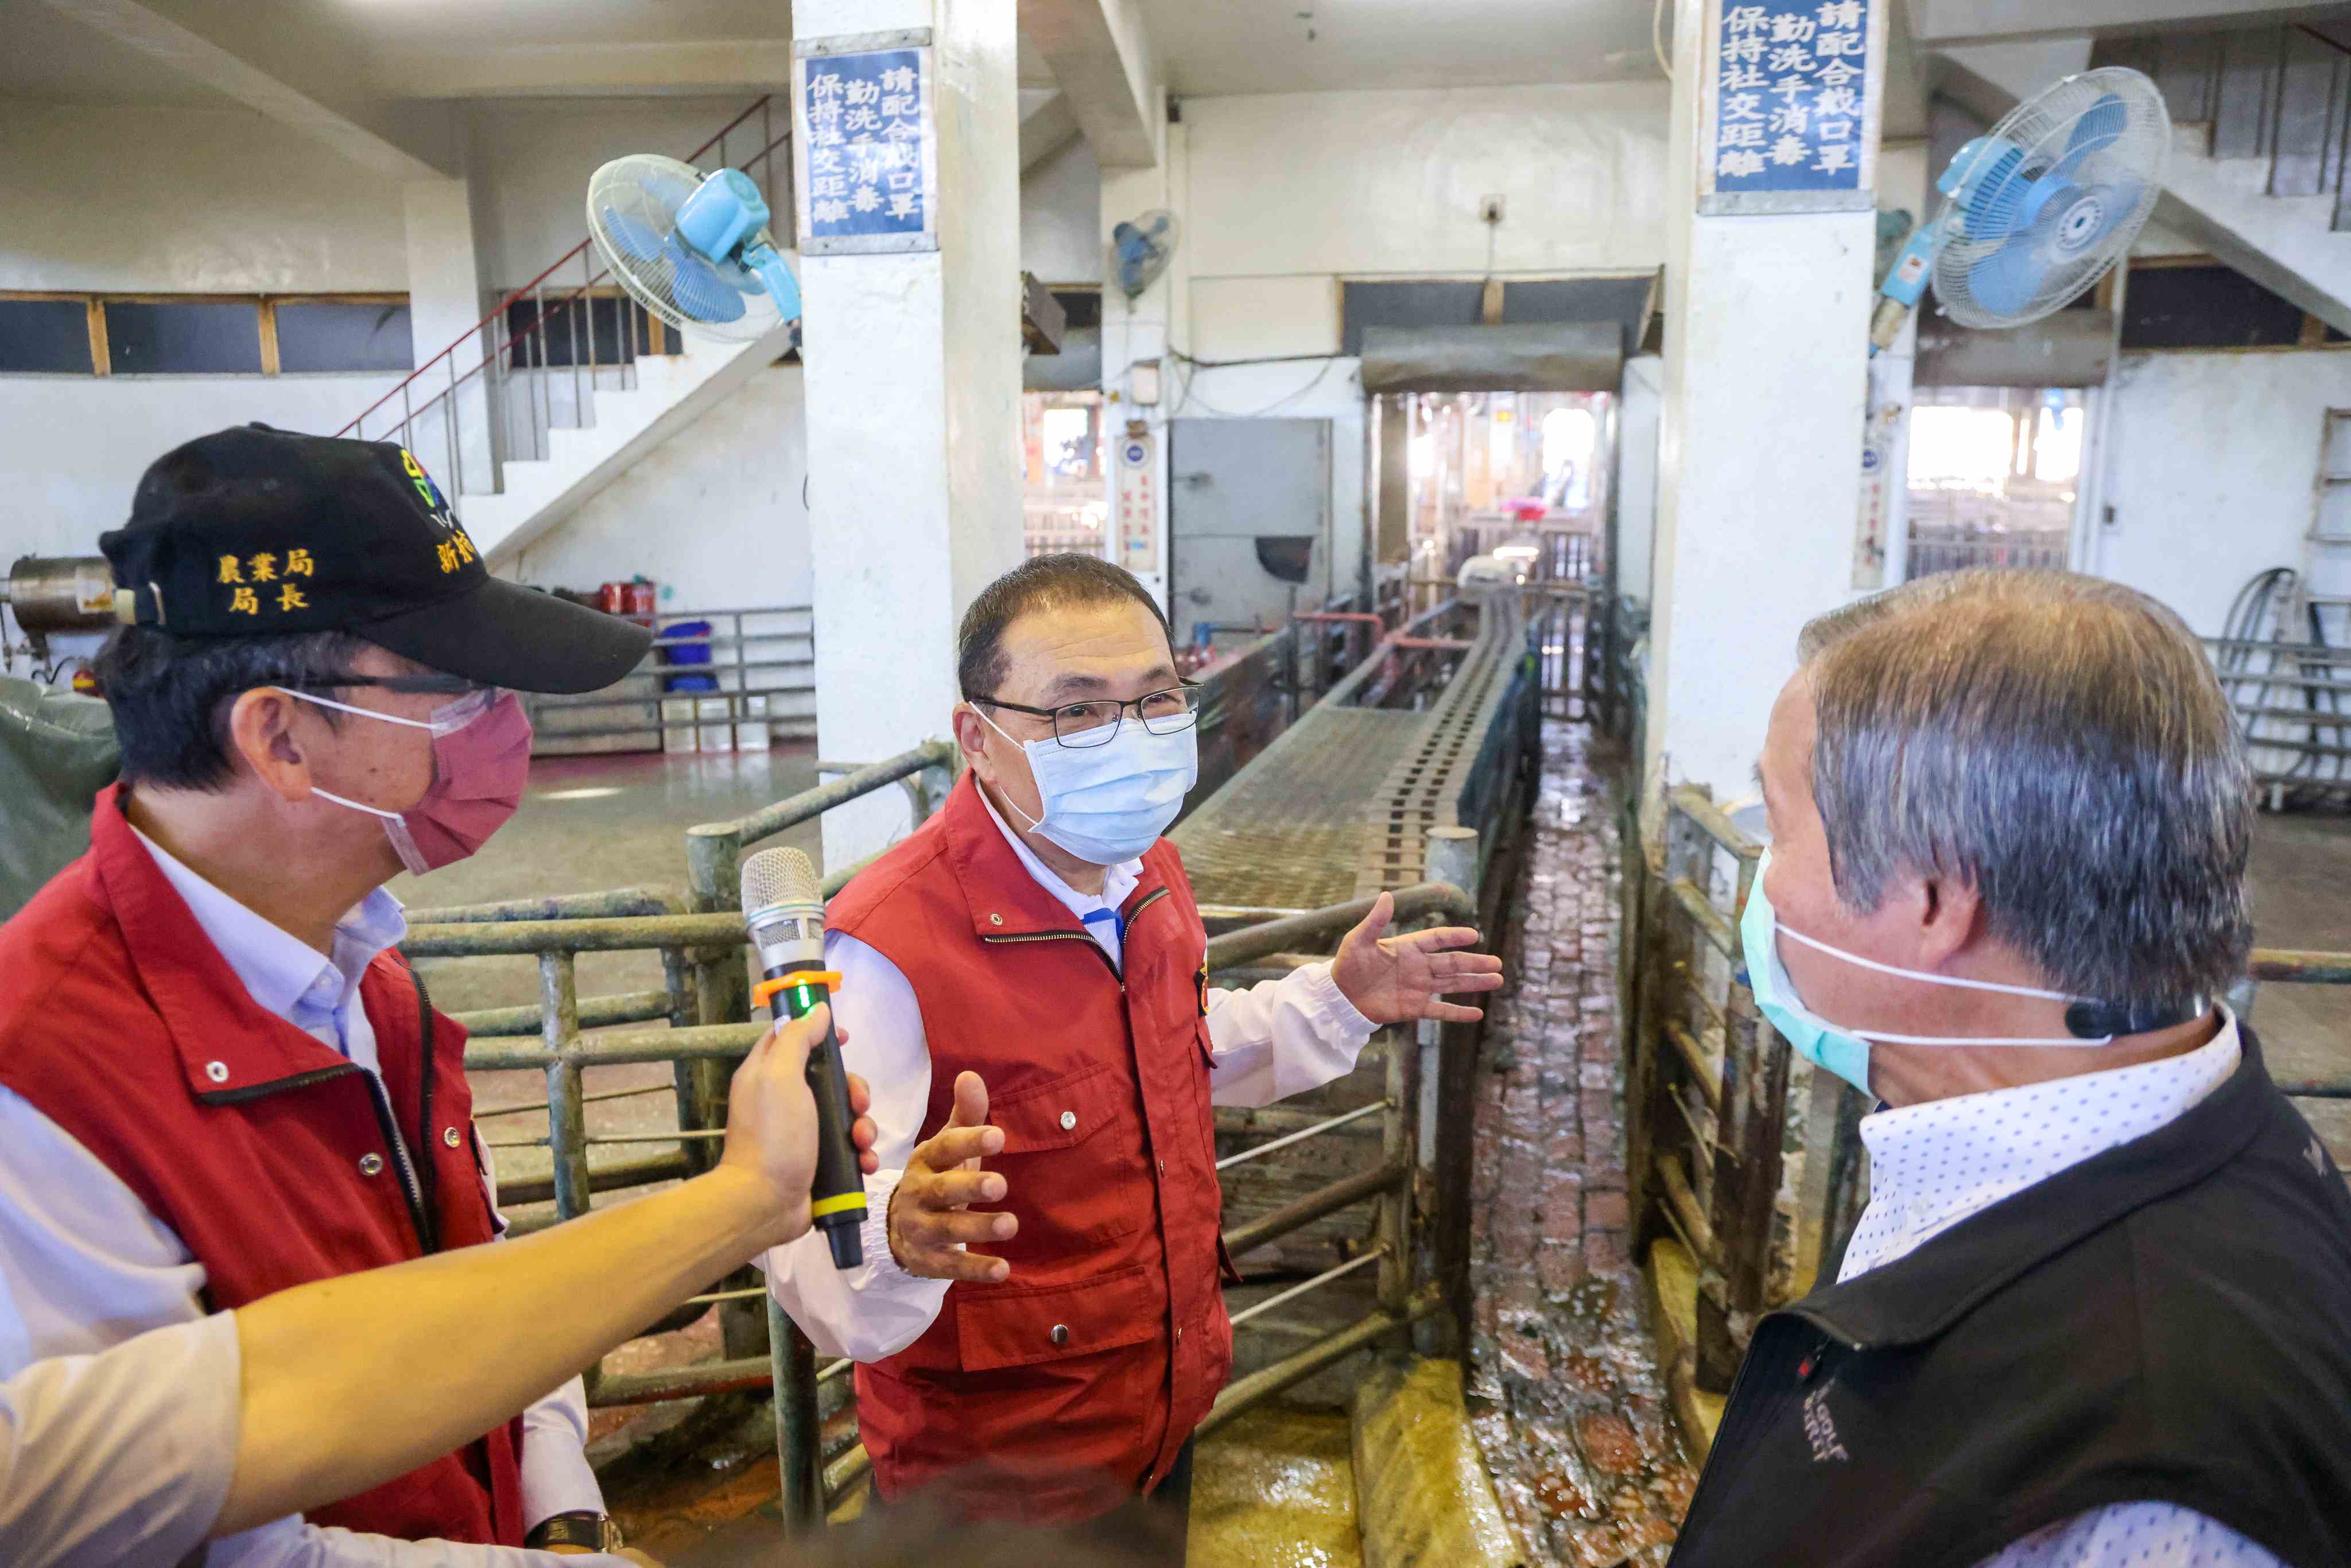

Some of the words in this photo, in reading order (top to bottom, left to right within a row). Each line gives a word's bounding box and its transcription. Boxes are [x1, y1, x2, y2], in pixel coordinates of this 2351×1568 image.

[808, 73, 849, 223] 保持社交距離
[844, 79, 884, 212] 勤洗手消毒
[879, 65, 920, 220] 請配合戴口罩
[1718, 6, 1771, 177] 保持社交距離
[1764, 13, 1818, 165] 勤洗手消毒
[1811, 0, 1865, 176] 請配合戴口罩
[216, 548, 315, 583] 農業局
[229, 583, 311, 616] 局長
